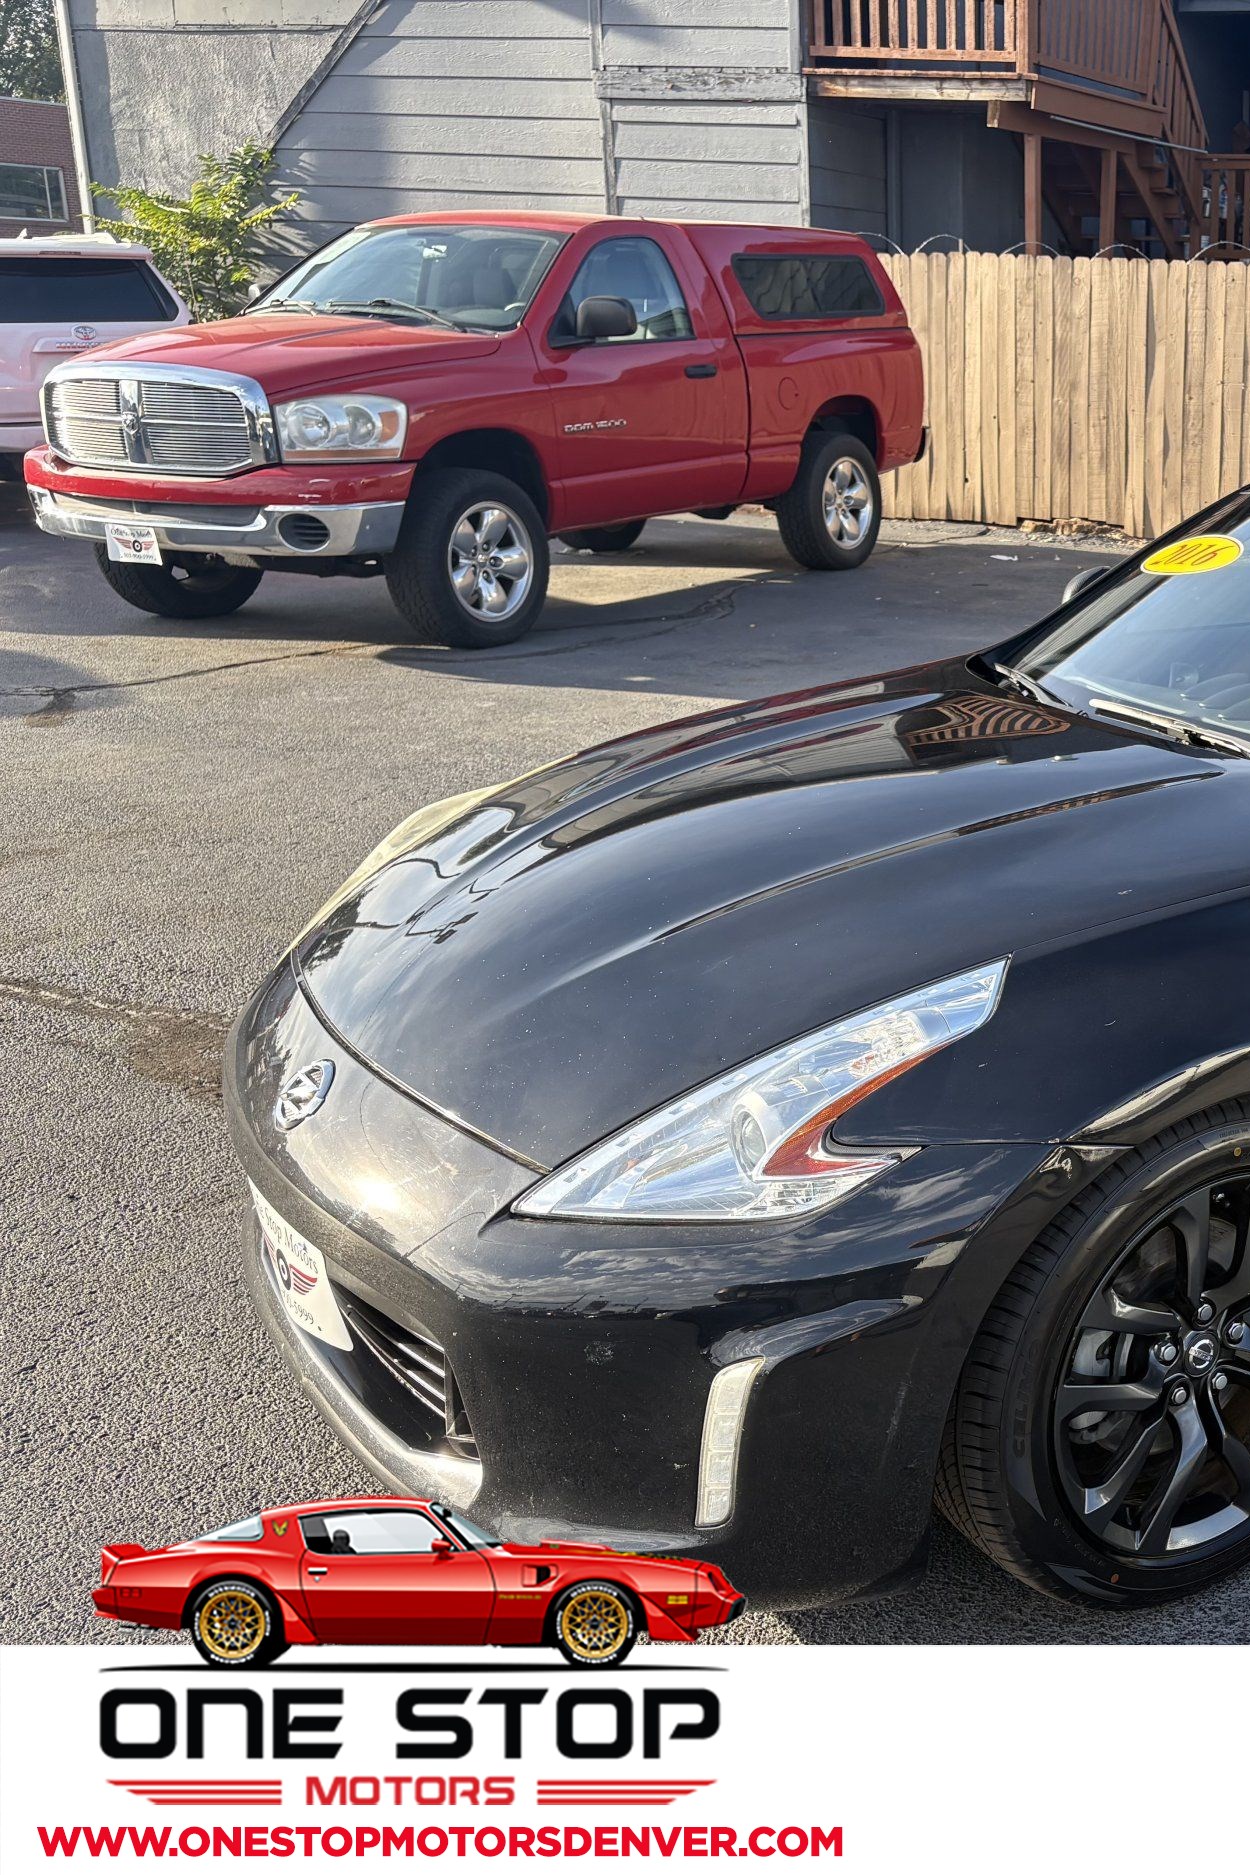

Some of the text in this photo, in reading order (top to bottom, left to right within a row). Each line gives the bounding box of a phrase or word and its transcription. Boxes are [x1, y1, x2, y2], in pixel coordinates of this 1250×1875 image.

[596, 419, 627, 428] 1500
[1148, 543, 1235, 566] 2016
[264, 1207, 282, 1242] Stop
